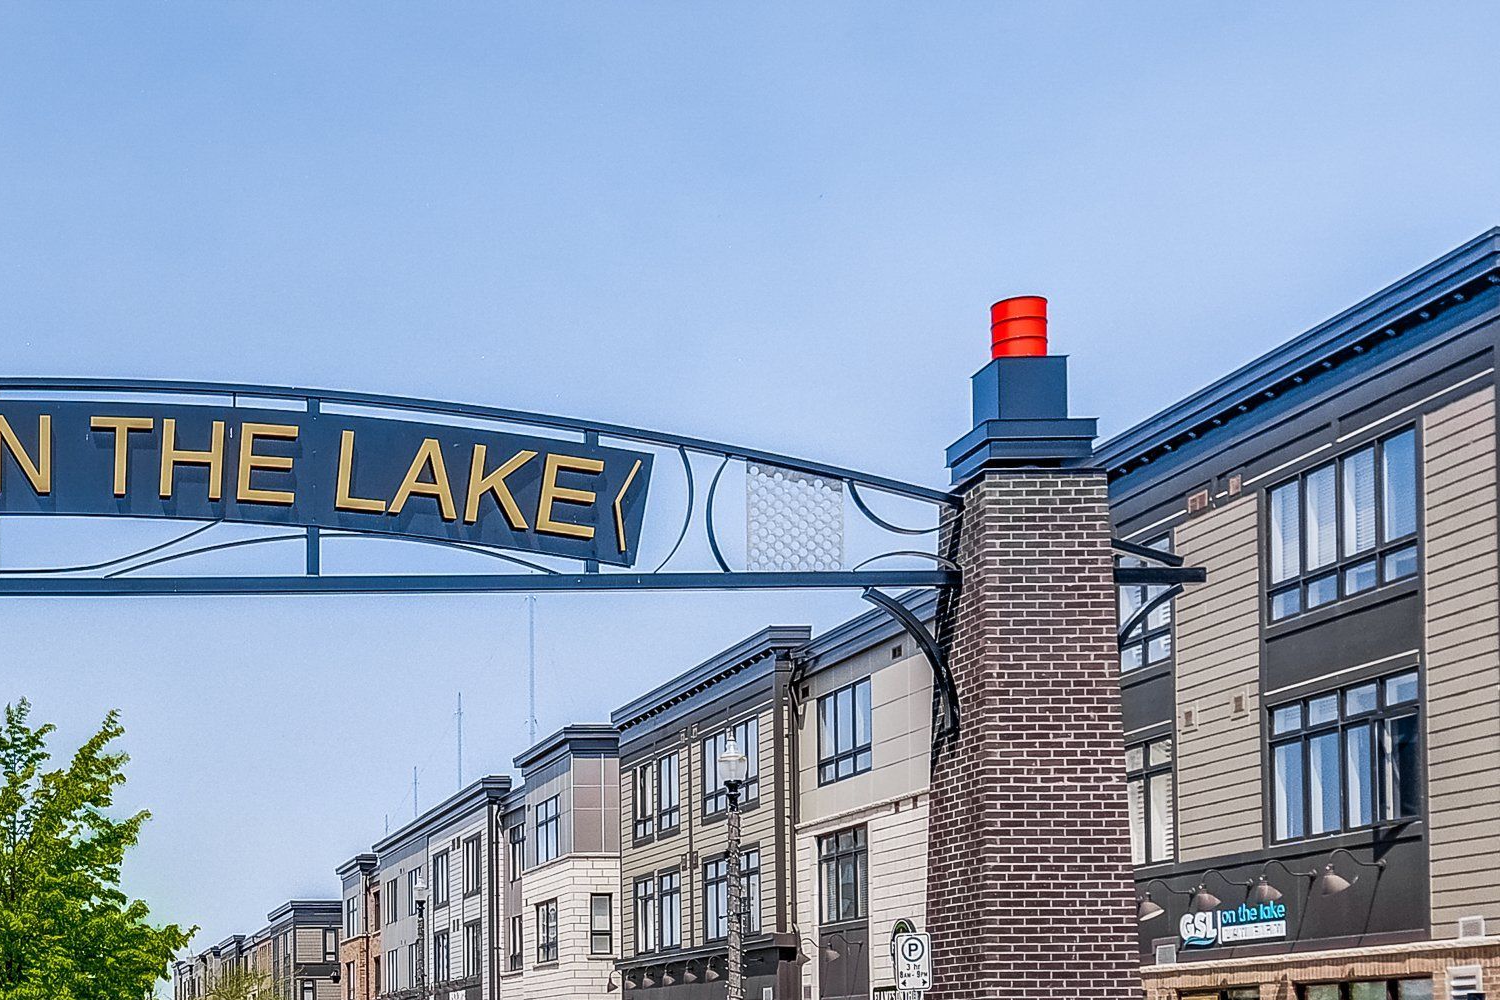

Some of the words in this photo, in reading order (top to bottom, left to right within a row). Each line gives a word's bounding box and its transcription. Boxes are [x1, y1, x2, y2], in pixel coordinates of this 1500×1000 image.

[90, 415, 300, 506] THE
[335, 429, 605, 540] LAKE
[1180, 911, 1218, 940] GSL
[1221, 909, 1236, 924] on
[1238, 903, 1258, 922] the
[1260, 900, 1286, 920] lake
[906, 963, 911, 971] 3
